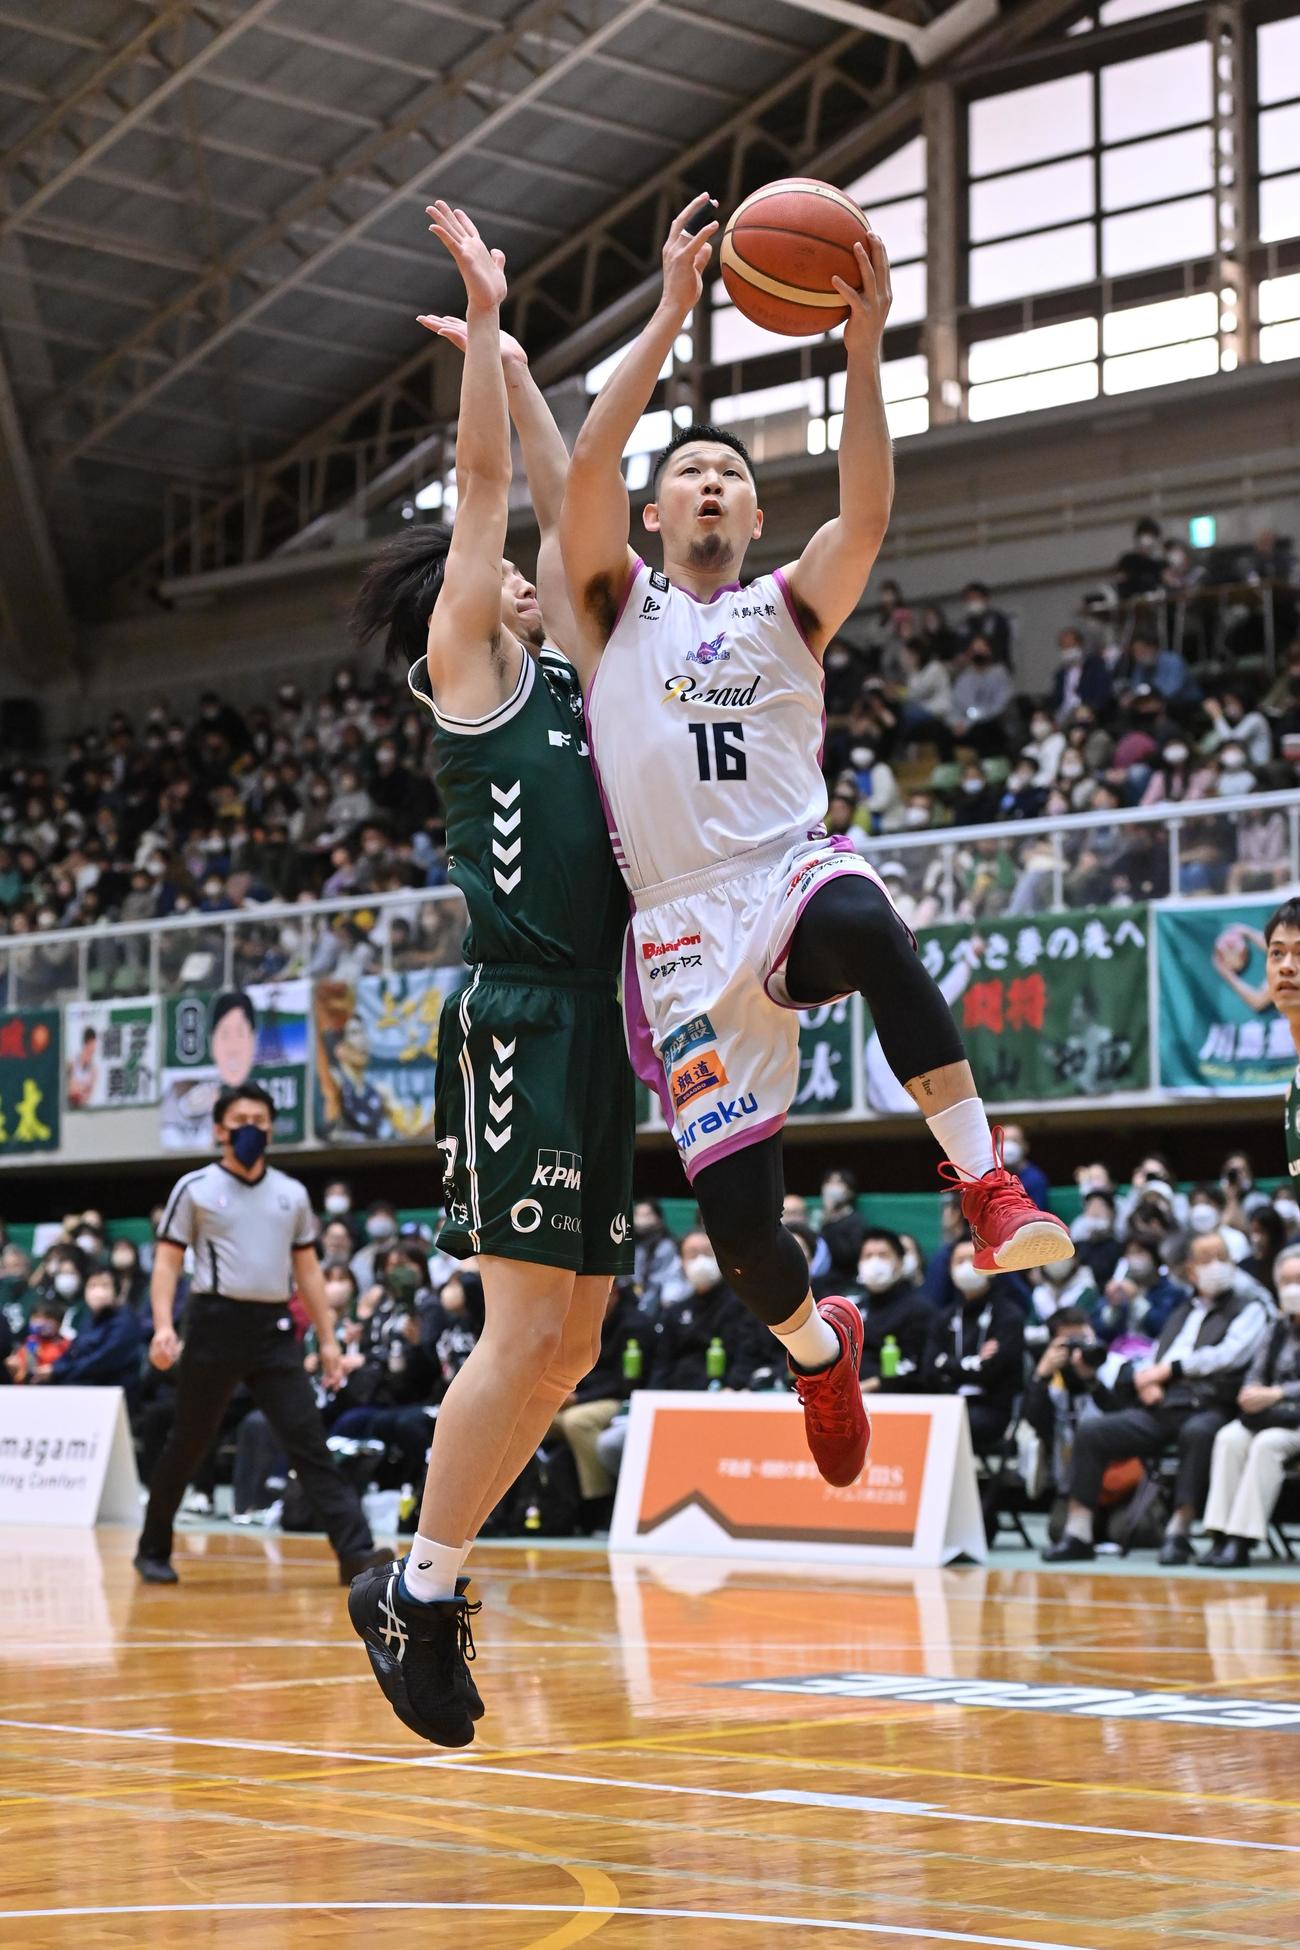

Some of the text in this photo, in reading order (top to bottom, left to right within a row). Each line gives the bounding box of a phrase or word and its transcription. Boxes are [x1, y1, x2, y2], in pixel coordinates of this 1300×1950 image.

[664, 675, 761, 707] Rezard
[688, 722, 747, 781] 16
[673, 1060, 715, 1096] 顔道
